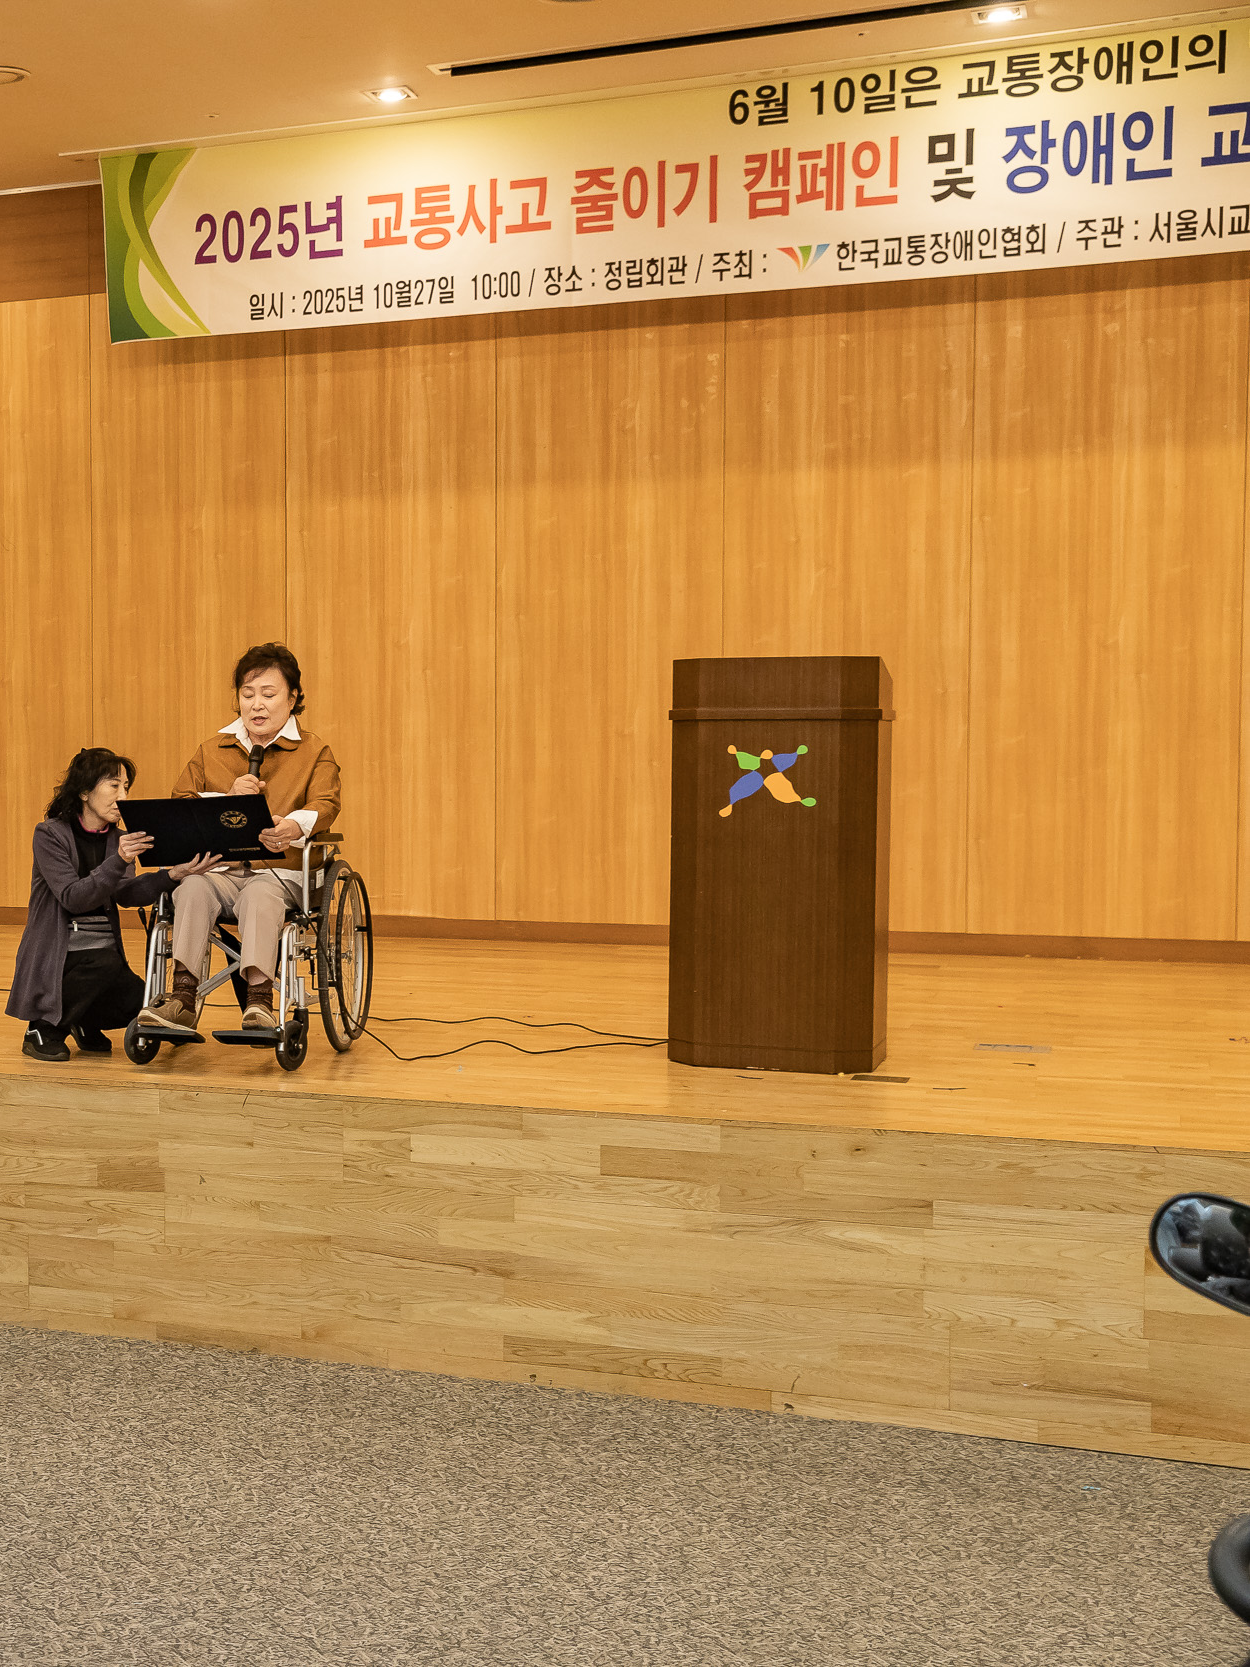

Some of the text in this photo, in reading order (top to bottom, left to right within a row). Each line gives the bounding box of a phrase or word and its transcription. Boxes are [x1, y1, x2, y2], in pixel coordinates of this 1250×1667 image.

[728, 29, 1227, 126] 6월 10일은 교통장애인의
[194, 101, 1250, 265] 2025년 교통사고 줄이기 캠페인 및 장애인 교
[249, 291, 284, 321] 일시
[302, 284, 364, 315] 2025년
[373, 275, 455, 309] 10월27일
[470, 270, 521, 301] 10:00
[543, 265, 583, 296] 장소
[604, 255, 688, 291] 정립회관
[711, 249, 753, 281] 주최
[836, 223, 1047, 271] 한국교통장애인협회
[1076, 216, 1124, 250] 주관
[1149, 204, 1250, 243] 서울시교
